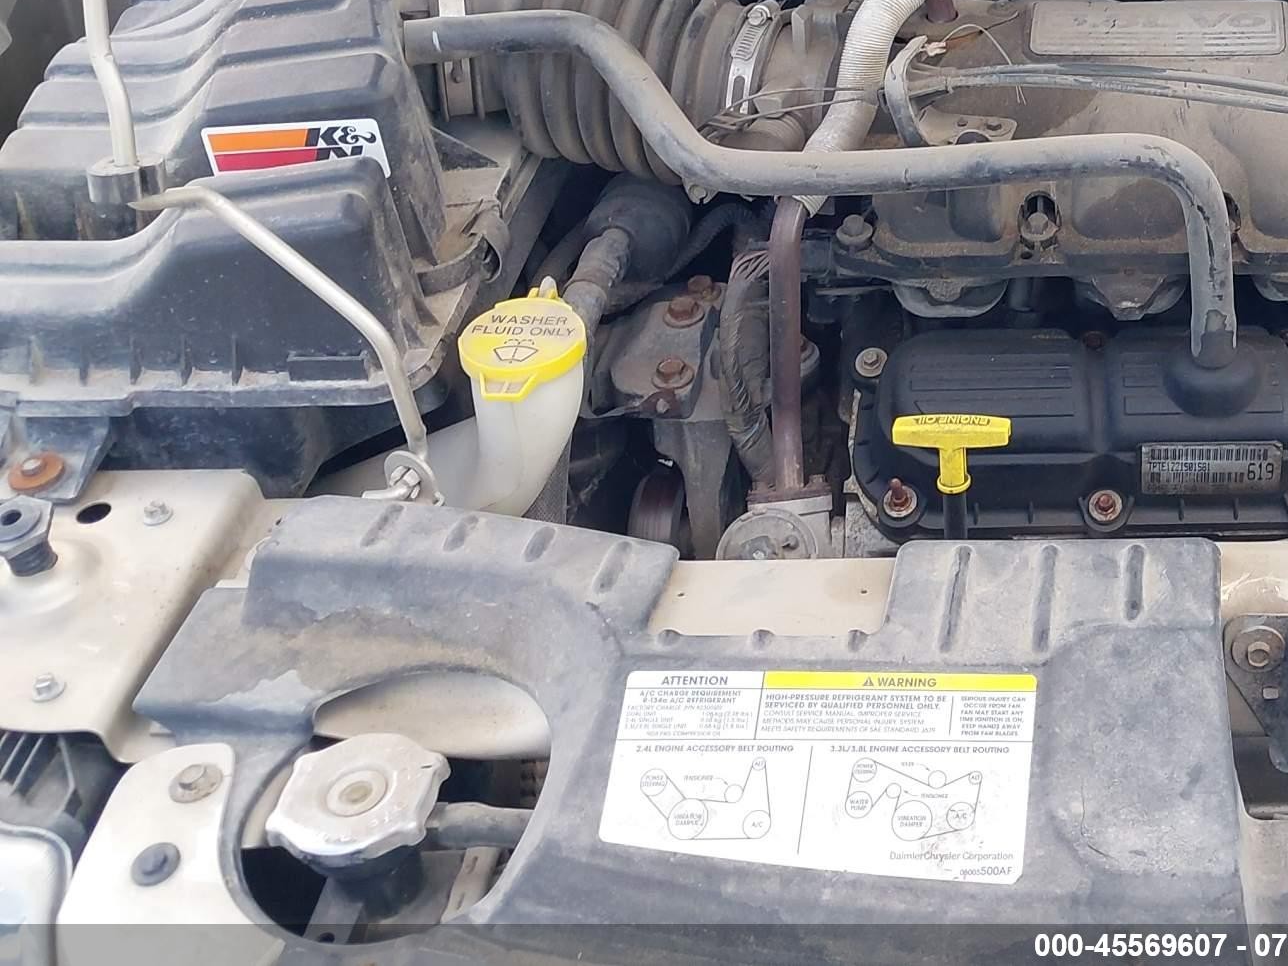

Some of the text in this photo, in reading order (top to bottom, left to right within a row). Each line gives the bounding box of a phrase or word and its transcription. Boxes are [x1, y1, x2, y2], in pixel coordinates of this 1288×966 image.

[491, 314, 568, 326] WASHER
[471, 325, 576, 337] FLUID ONLY
[914, 415, 990, 426] ENGINE OIL
[1247, 462, 1275, 481] 619
[661, 675, 729, 686] ATTENTION
[877, 677, 937, 687] WARNING
[766, 693, 830, 701] HIGH-PRESSURE
[832, 694, 887, 702] REFRIGERANT
[890, 694, 921, 702] SYSTEM
[936, 695, 947, 703] BE
[764, 701, 805, 709] SERVICED
[866, 702, 914, 710] PERSONNEL
[636, 745, 795, 753] 2.4L ENGINE ACCESSORY BELT ROUTING
[868, 745, 899, 754] ENGINE
[901, 745, 951, 754] ACCESSORY
[953, 746, 970, 754] BELT
[972, 746, 1010, 754] ROUTING
[954, 812, 967, 820] A/C
[889, 850, 1014, 863] DaimlerChrysler Corporation
